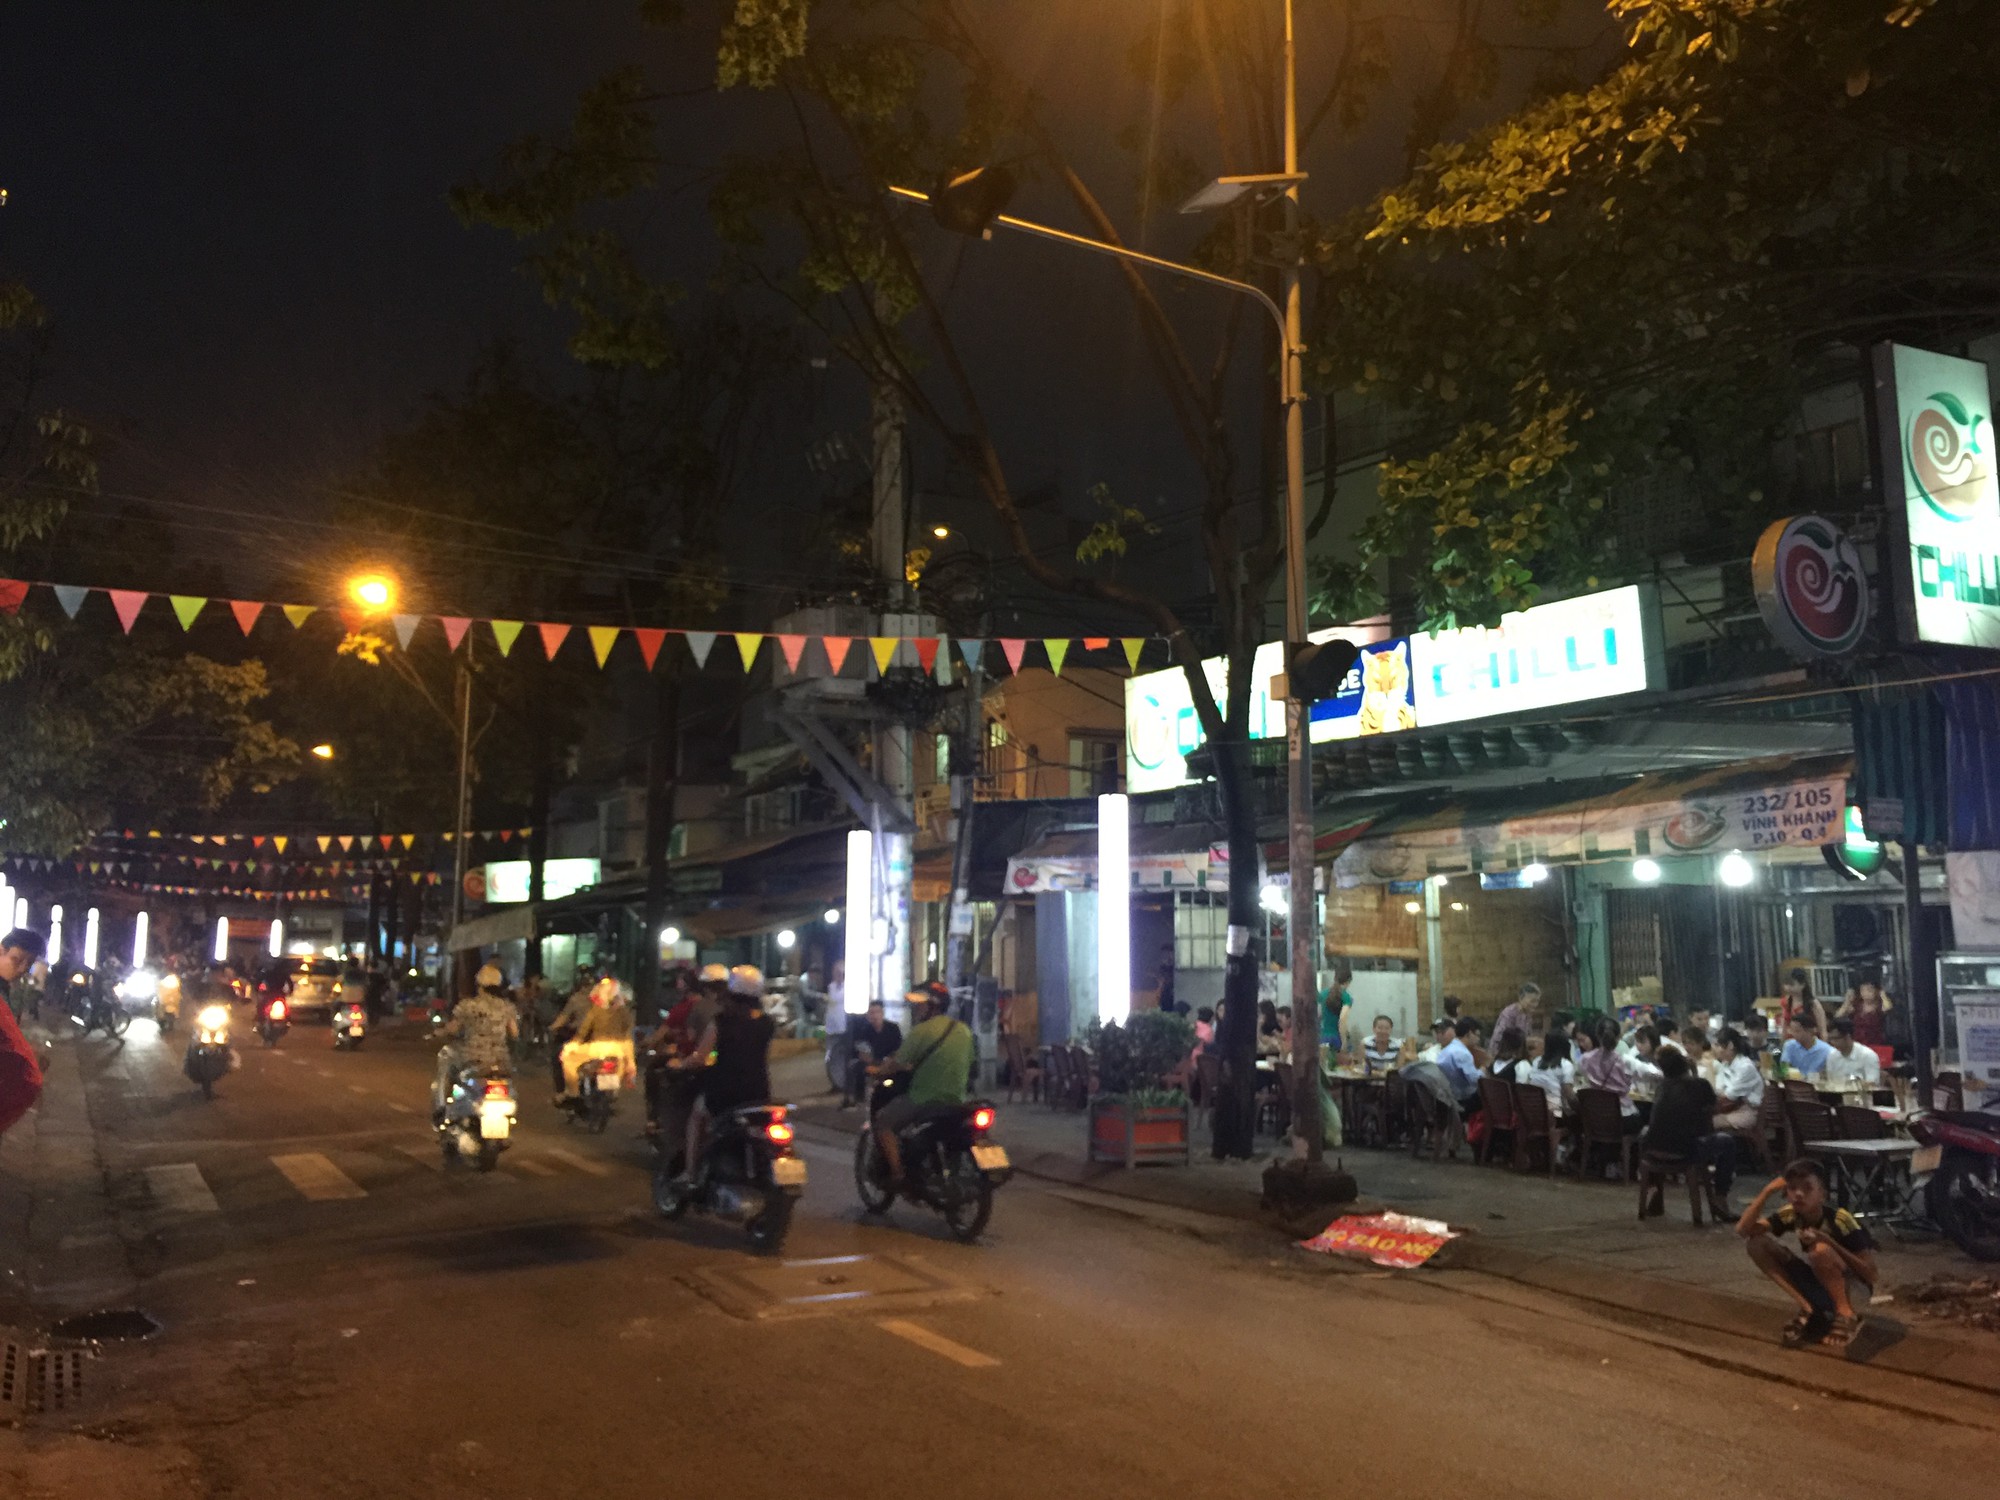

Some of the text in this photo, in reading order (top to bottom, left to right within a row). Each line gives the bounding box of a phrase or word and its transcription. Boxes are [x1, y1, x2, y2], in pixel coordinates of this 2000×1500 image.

[1431, 626, 1618, 699] CHILLI
[1743, 787, 1832, 814] 232/105
[1753, 830, 1787, 844] P.10
